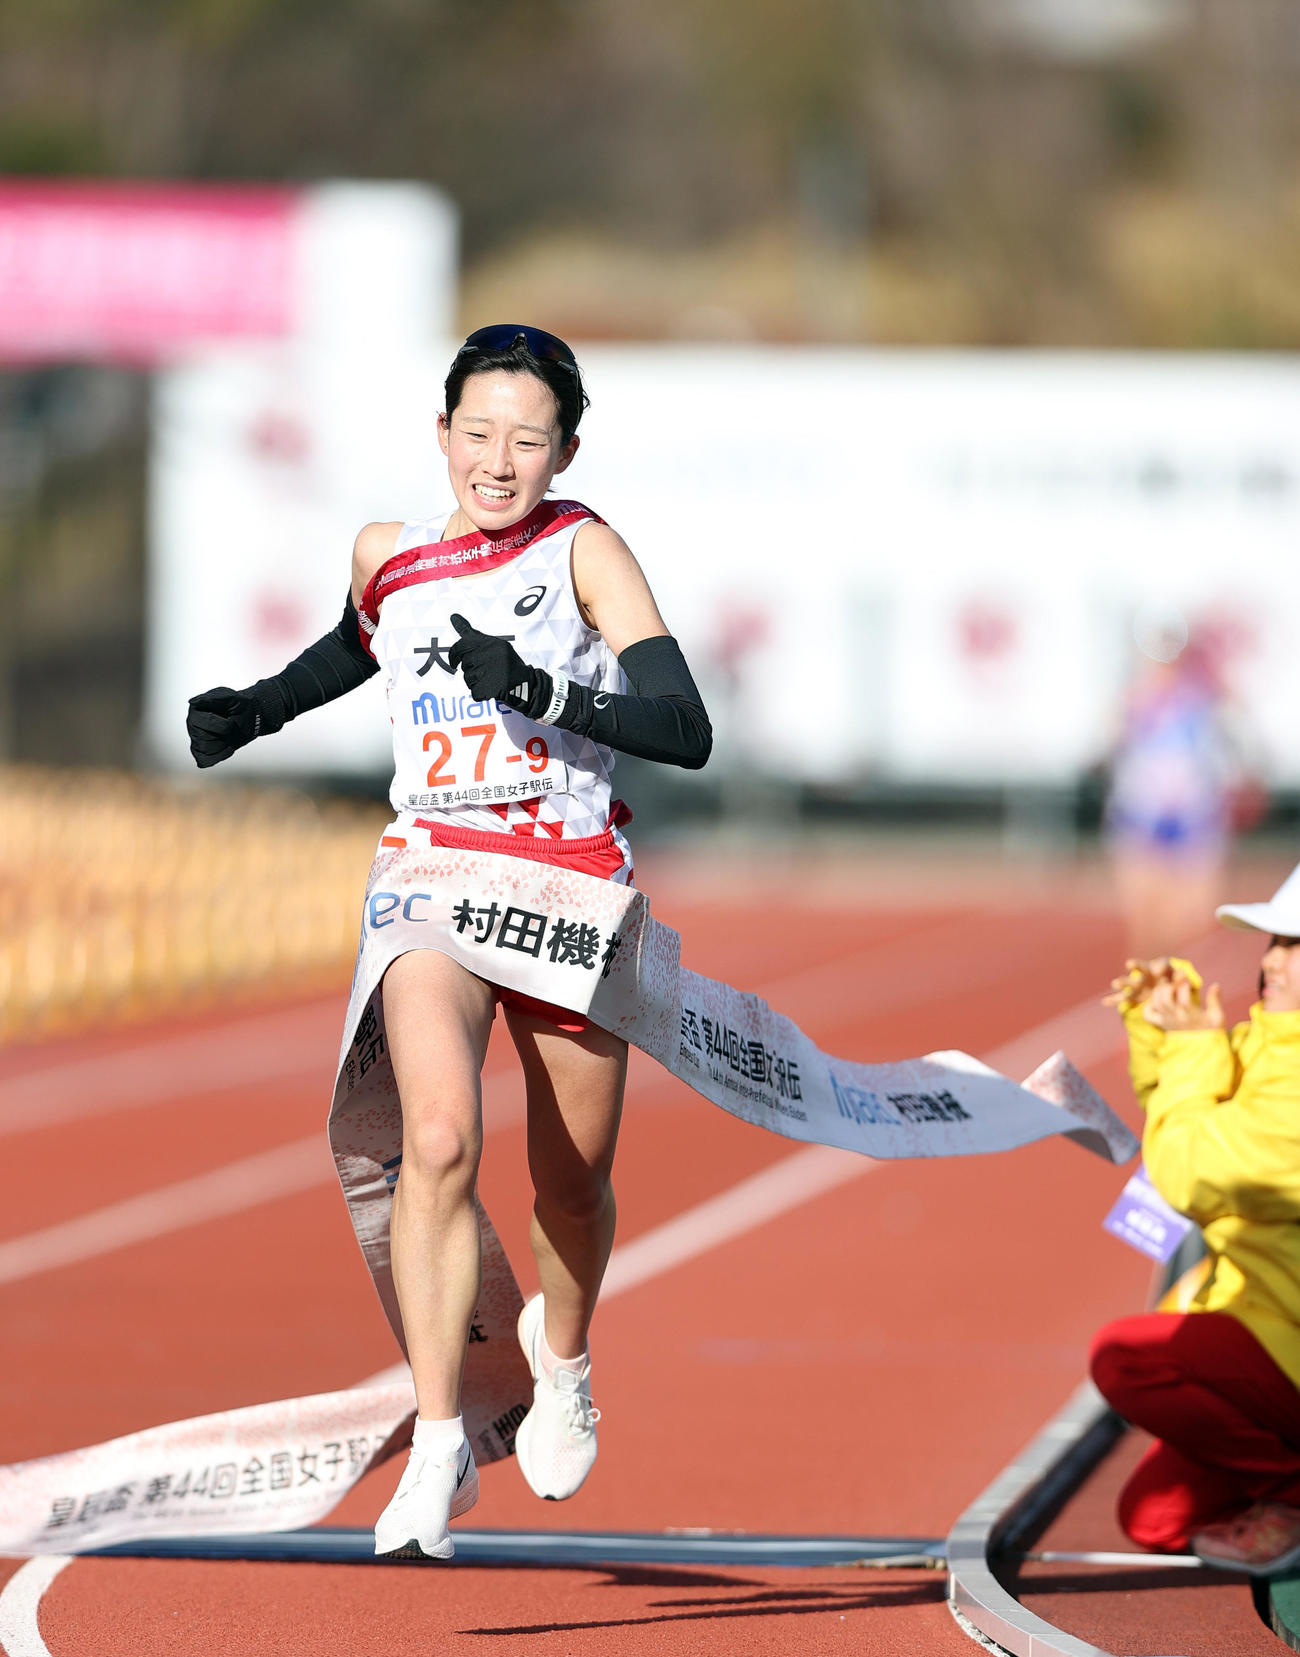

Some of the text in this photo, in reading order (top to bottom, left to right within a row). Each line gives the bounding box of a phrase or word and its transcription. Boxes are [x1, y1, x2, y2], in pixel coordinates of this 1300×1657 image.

[422, 723, 549, 788] 27-9
[408, 777, 554, 806] 皇后盃 第44回全国女子駅伝
